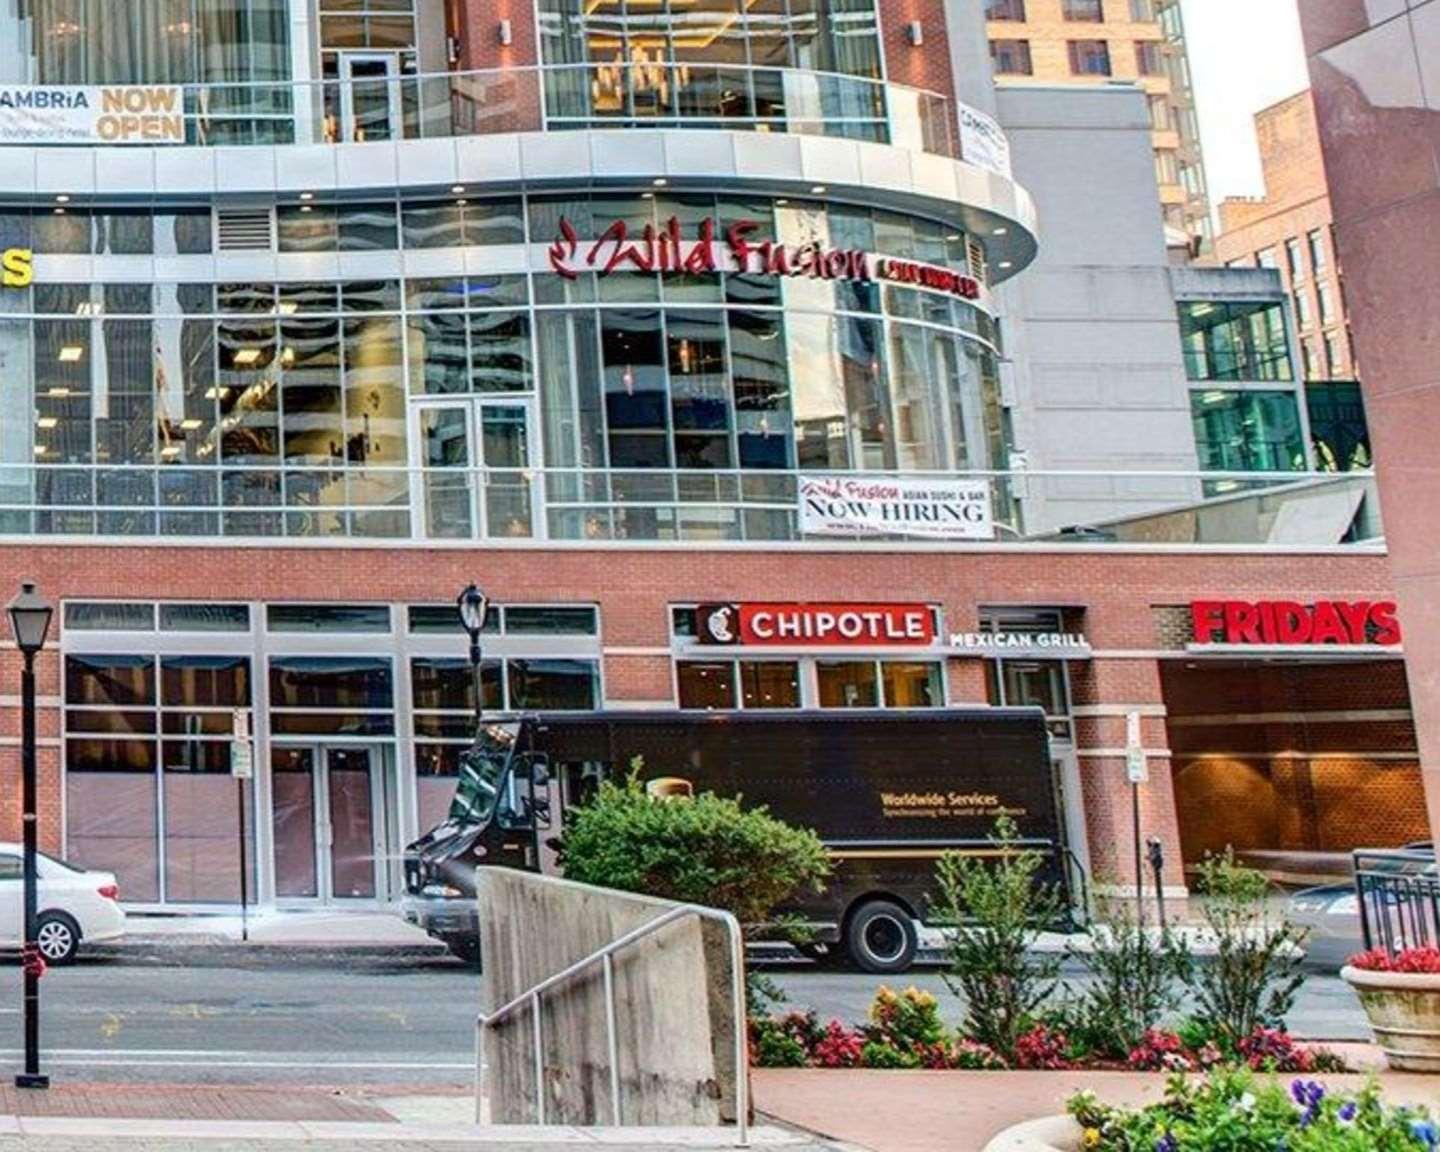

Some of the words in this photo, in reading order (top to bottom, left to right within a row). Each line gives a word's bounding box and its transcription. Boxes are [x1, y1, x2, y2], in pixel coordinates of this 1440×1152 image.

[101, 88, 178, 113] NOW
[96, 115, 182, 140] OPEN
[587, 215, 715, 277] Wild
[727, 218, 871, 281] Fusion
[845, 480, 900, 501] Fusion
[805, 498, 873, 519] NOW
[880, 504, 984, 523] HIRING
[750, 611, 925, 639] CHIPOTLE
[1190, 600, 1403, 646] FRIDAYS
[949, 632, 1033, 649] MEXICAN
[1036, 633, 1089, 649] GRILL
[880, 792, 946, 806] Worldwide
[948, 792, 999, 806] Services
